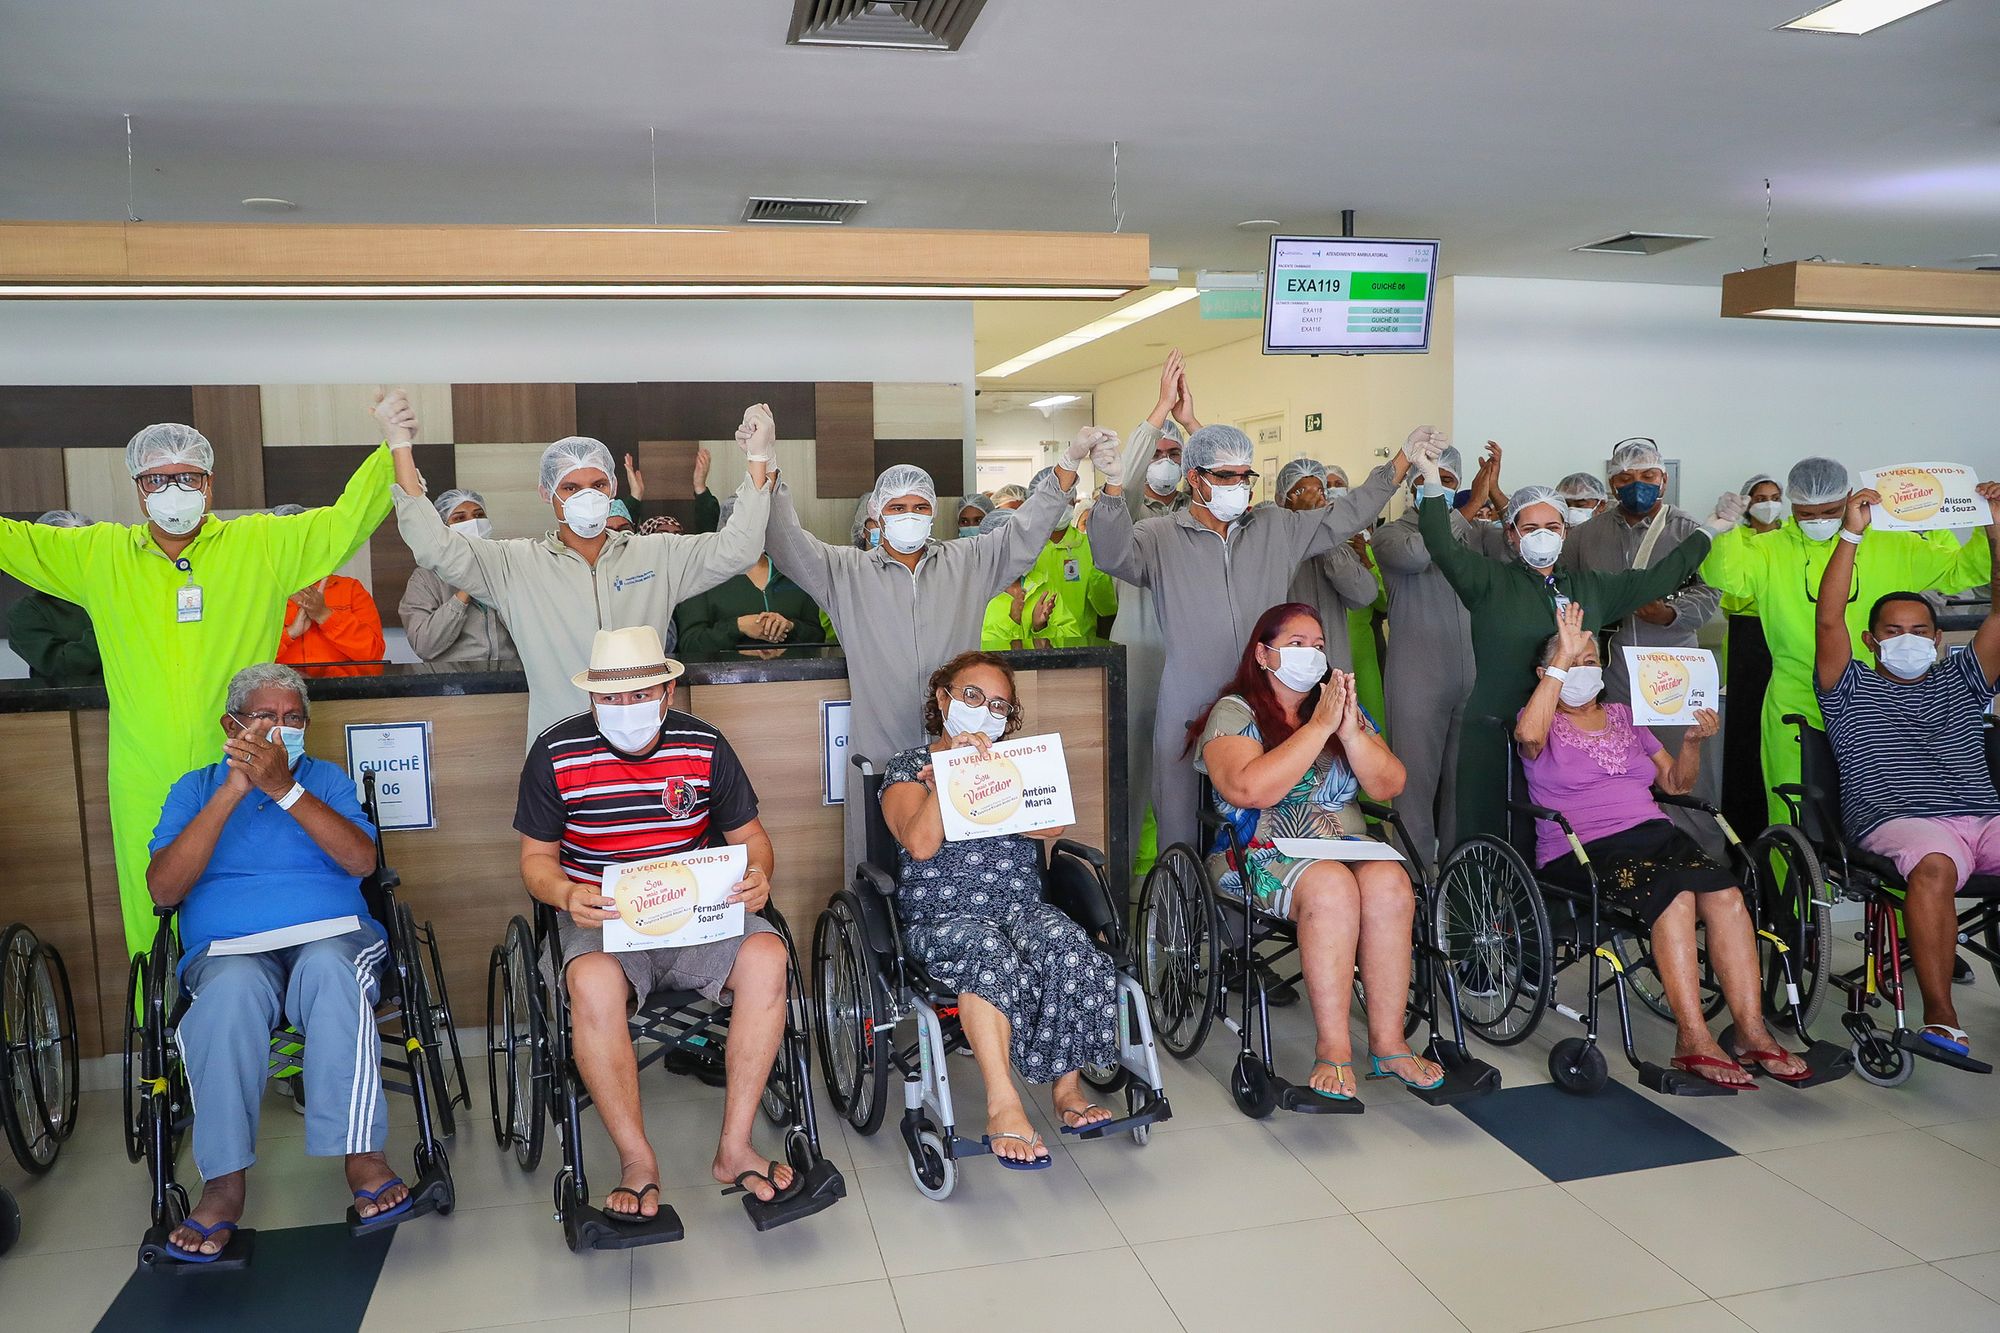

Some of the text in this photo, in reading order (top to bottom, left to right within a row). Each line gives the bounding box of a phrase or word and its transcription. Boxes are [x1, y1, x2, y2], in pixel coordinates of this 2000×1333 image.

[1288, 278, 1340, 293] EXA119
[1890, 488, 1934, 505] Vencedor
[1649, 678, 1682, 695] Vencedor
[360, 755, 420, 772] GUICHÊ
[949, 744, 1047, 767] EU VENCI A COVID-19
[974, 773, 990, 785] Sou
[382, 783, 400, 795] 06
[963, 778, 1012, 805] Vencedor
[1025, 798, 1052, 808] Maria
[637, 862, 668, 873] VENCI
[681, 854, 730, 866] COVID-19
[644, 879, 663, 892] Sou
[630, 887, 686, 913] Vencedor
[693, 901, 730, 913] Fernando
[698, 912, 724, 923] Soares
